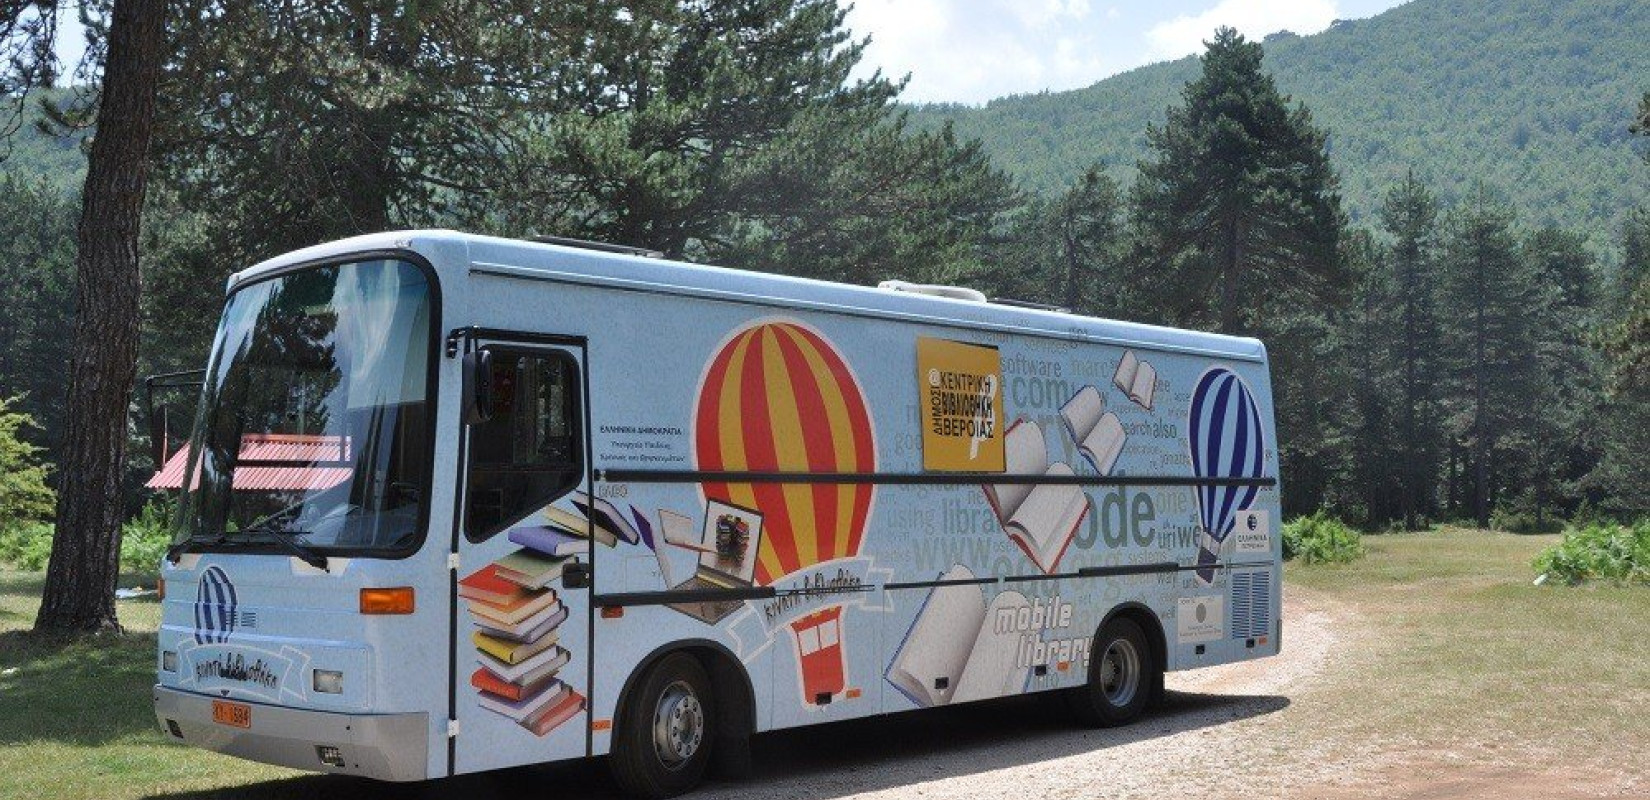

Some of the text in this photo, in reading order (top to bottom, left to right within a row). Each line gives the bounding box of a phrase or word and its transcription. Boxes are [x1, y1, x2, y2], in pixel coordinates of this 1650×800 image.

[1000, 353, 1062, 378] software
[943, 418, 994, 439] ΒΕΡΟΙΑΣ
[1152, 417, 1178, 439] also
[992, 595, 1073, 635] mobile
[1016, 632, 1095, 669] library
